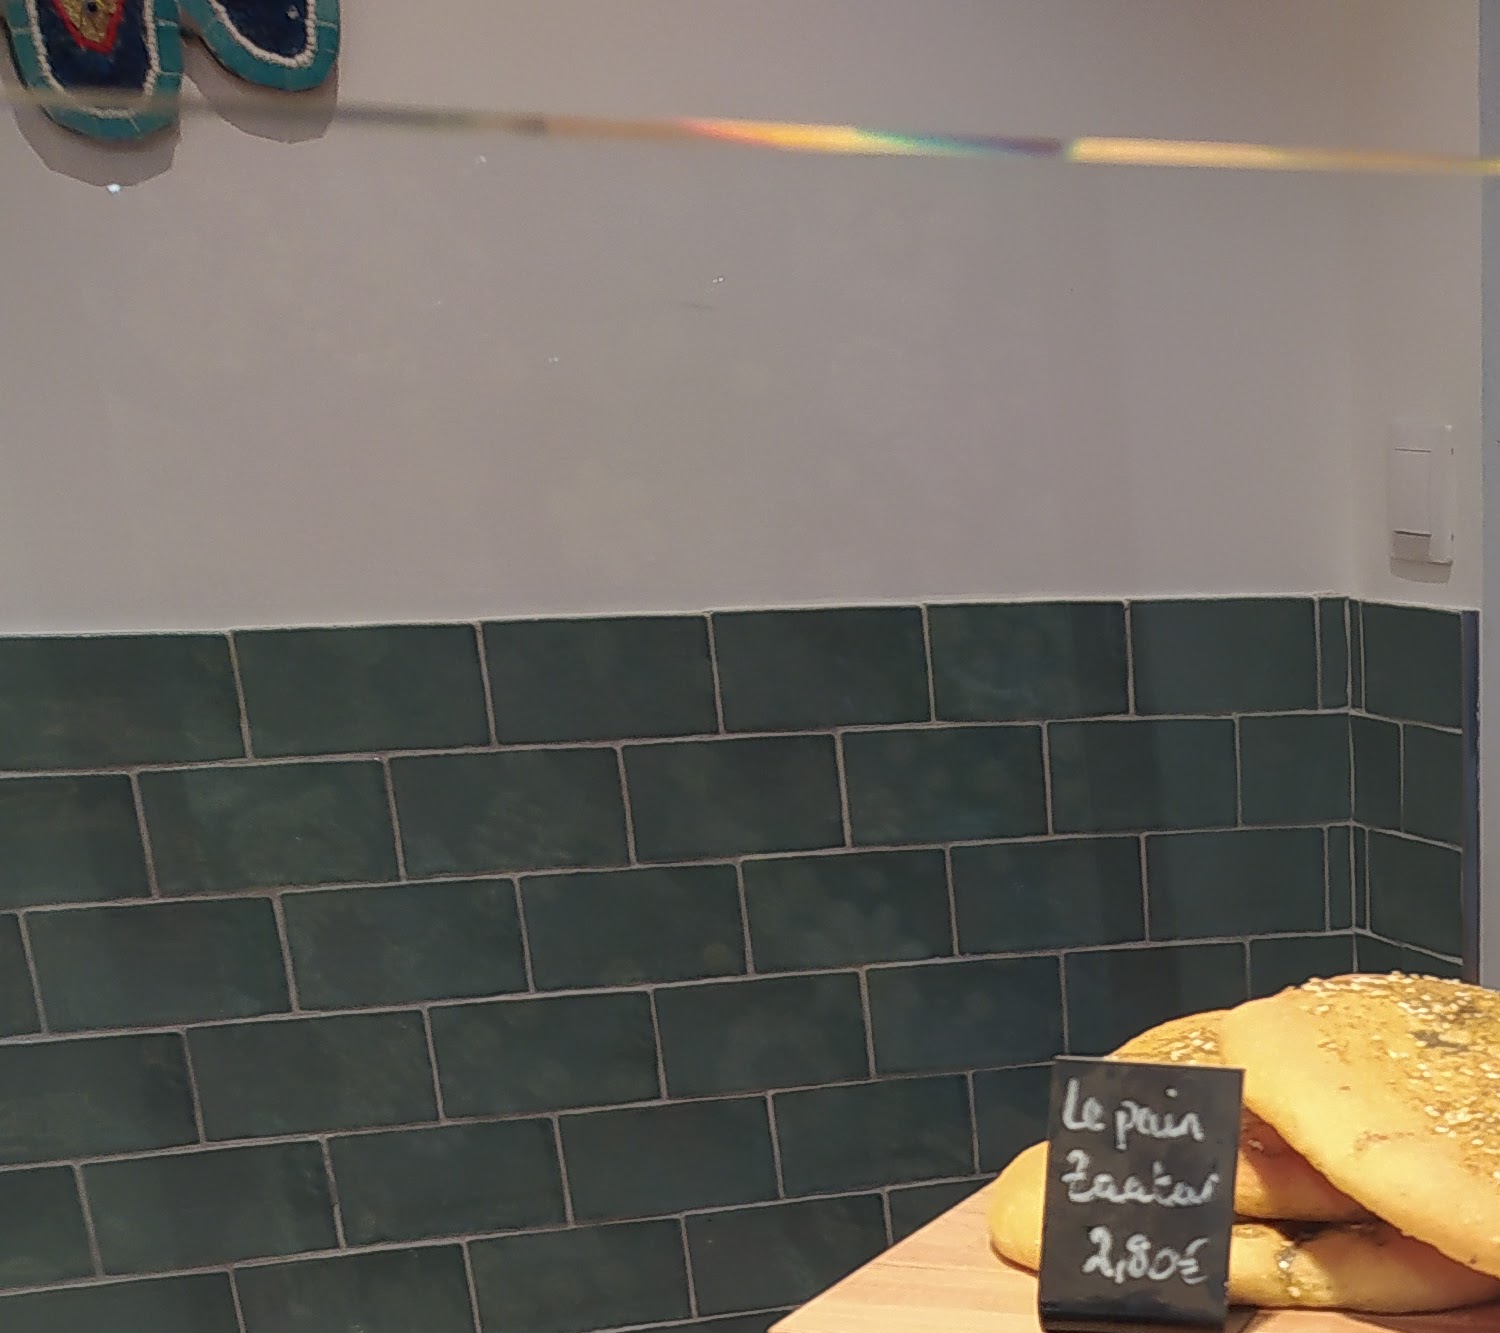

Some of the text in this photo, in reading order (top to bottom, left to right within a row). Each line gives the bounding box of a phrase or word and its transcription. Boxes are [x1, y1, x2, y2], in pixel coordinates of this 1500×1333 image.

[1062, 1077, 1205, 1150] Le pain
[1082, 1226, 1208, 1285] 2,80€
